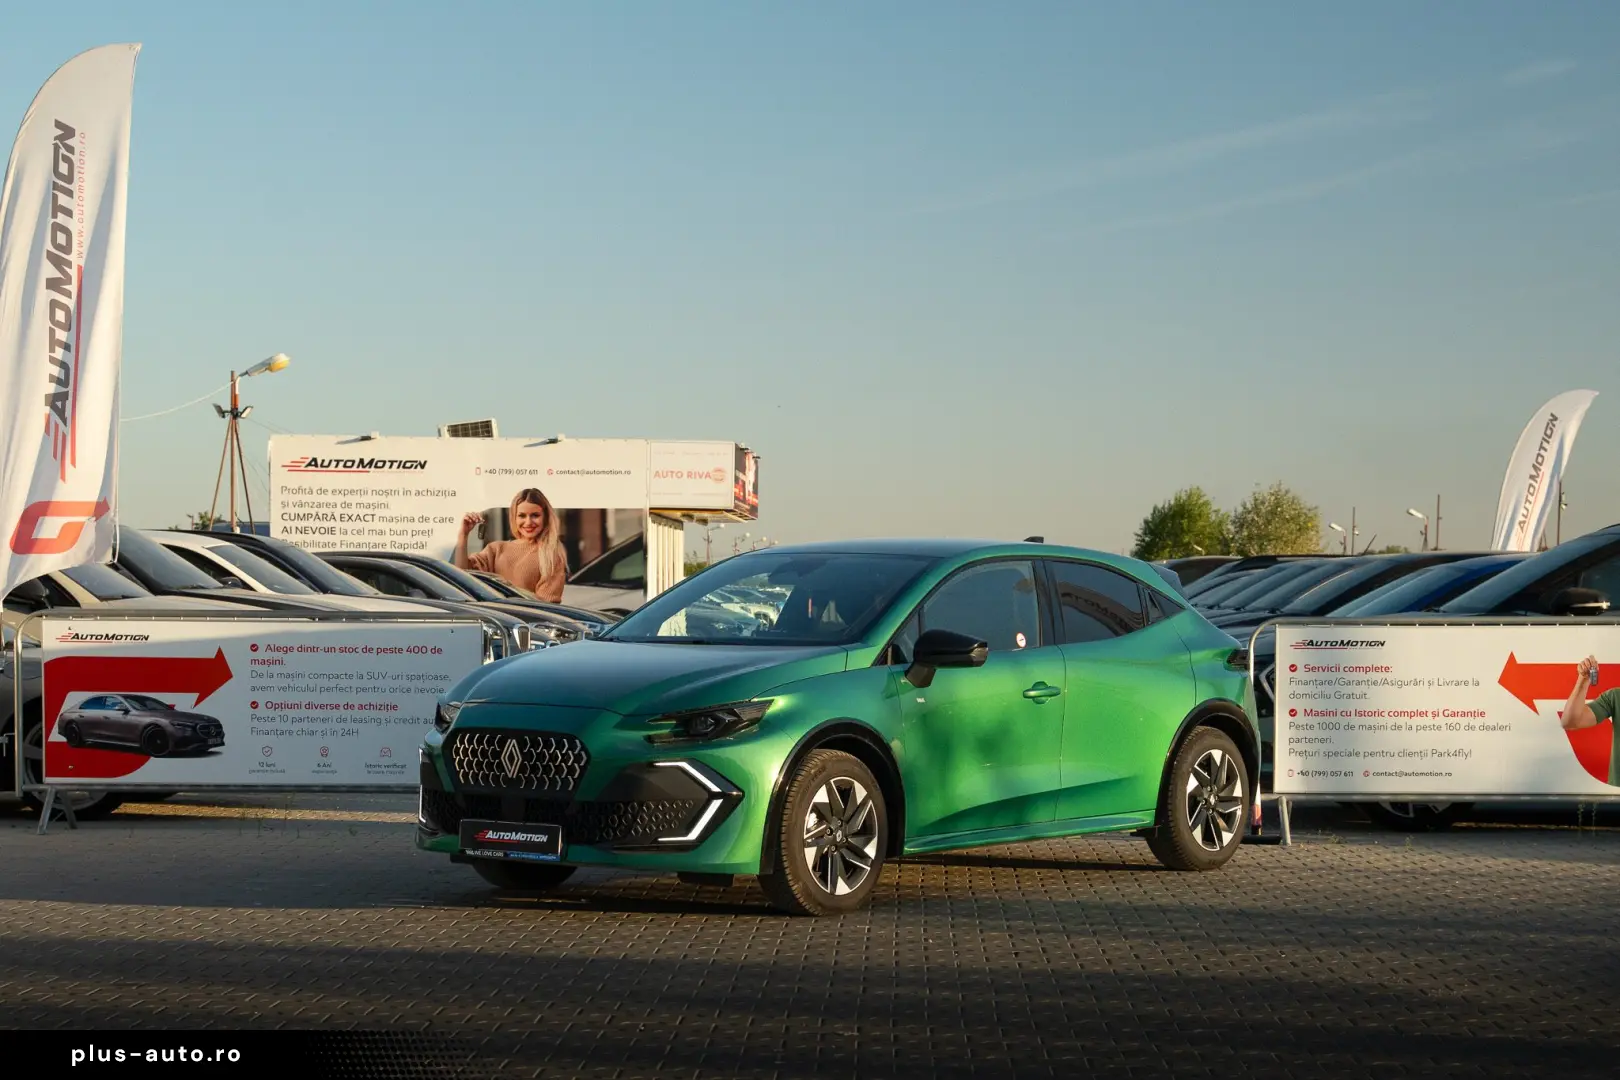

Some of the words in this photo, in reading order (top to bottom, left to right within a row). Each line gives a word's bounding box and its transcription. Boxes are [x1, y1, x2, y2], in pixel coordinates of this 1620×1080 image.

[77, 132, 86, 258] www.automotion.ro
[498, 468, 514, 477] (799)
[556, 468, 631, 477] contact@automotion.ro
[653, 470, 683, 479] AUTO
[687, 470, 712, 480] RIVA
[316, 486, 328, 496] de
[371, 487, 400, 498] noștri
[402, 487, 412, 497] în
[292, 500, 337, 509] vânzarea
[340, 500, 352, 510] de
[281, 512, 337, 523] CUMPĂRĂ
[340, 514, 376, 523] EXACT
[418, 514, 430, 523] de
[433, 516, 454, 524] care
[281, 526, 292, 535] AI
[295, 526, 336, 535] NEVOIE
[340, 527, 348, 535] la
[351, 527, 364, 536] cel
[368, 527, 386, 536] mai
[389, 528, 408, 536] bun
[340, 539, 387, 550] Finanțare
[265, 644, 294, 654] Alege
[297, 645, 336, 654] dintr-un
[338, 645, 359, 654] stoc
[362, 645, 374, 654] de
[376, 646, 403, 655] peste
[406, 646, 428, 654] 400
[430, 646, 442, 654] de
[1304, 664, 1340, 673] Servicii
[1343, 664, 1392, 674] complete:
[250, 671, 264, 679] De
[267, 671, 274, 679] la
[277, 671, 305, 681] mașini
[308, 672, 353, 682] compacte
[356, 671, 364, 680] la
[367, 672, 403, 680] SUV-uri
[1428, 678, 1435, 689] și
[1437, 678, 1469, 687] Livrare
[1472, 678, 1480, 687] la
[278, 684, 317, 693] vehiculul
[320, 684, 352, 695] perfect
[356, 686, 386, 695] pentru
[389, 686, 412, 694] orice
[415, 686, 446, 694] nevoie.
[1289, 690, 1332, 700] domiciliu
[1334, 690, 1370, 700] Gratuit.
[265, 701, 302, 712] Opțiuni
[304, 701, 340, 710] diverse
[343, 702, 355, 710] de
[358, 702, 399, 712] achiziție
[1340, 710, 1352, 718] cu
[1354, 708, 1386, 718] Istoric
[1388, 709, 1428, 720] complet
[1431, 709, 1440, 720] și
[1442, 709, 1486, 720] Garanție
[250, 714, 276, 723] Peste
[278, 714, 288, 723] 10
[292, 715, 333, 725] parteneri
[336, 715, 348, 724] de
[350, 716, 381, 726] leasing
[394, 716, 420, 724] credit
[250, 728, 294, 738] Finanțare
[296, 728, 318, 736] chiar
[341, 728, 359, 737] 24H
[1289, 722, 1314, 732] Peste
[1317, 722, 1340, 732] 1000
[1343, 722, 1356, 732] de
[1358, 722, 1388, 734] mașini
[1390, 722, 1403, 732] de
[1405, 722, 1413, 732] la
[1416, 723, 1442, 734] peste
[1445, 722, 1461, 732] 160
[1464, 722, 1476, 732] de
[1479, 722, 1511, 732] dealeri
[1288, 736, 1334, 746] parteneri.
[1289, 749, 1320, 760] Prețuri
[1323, 749, 1360, 760] speciale
[1363, 750, 1396, 760] pentru
[1398, 749, 1428, 760] clienții
[1431, 749, 1472, 760] Park4fly!
[1311, 770, 1328, 778] (799)
[1330, 770, 1342, 778] 057
[1344, 770, 1354, 778] 611
[1372, 770, 1452, 778] contact@automotion.ro
